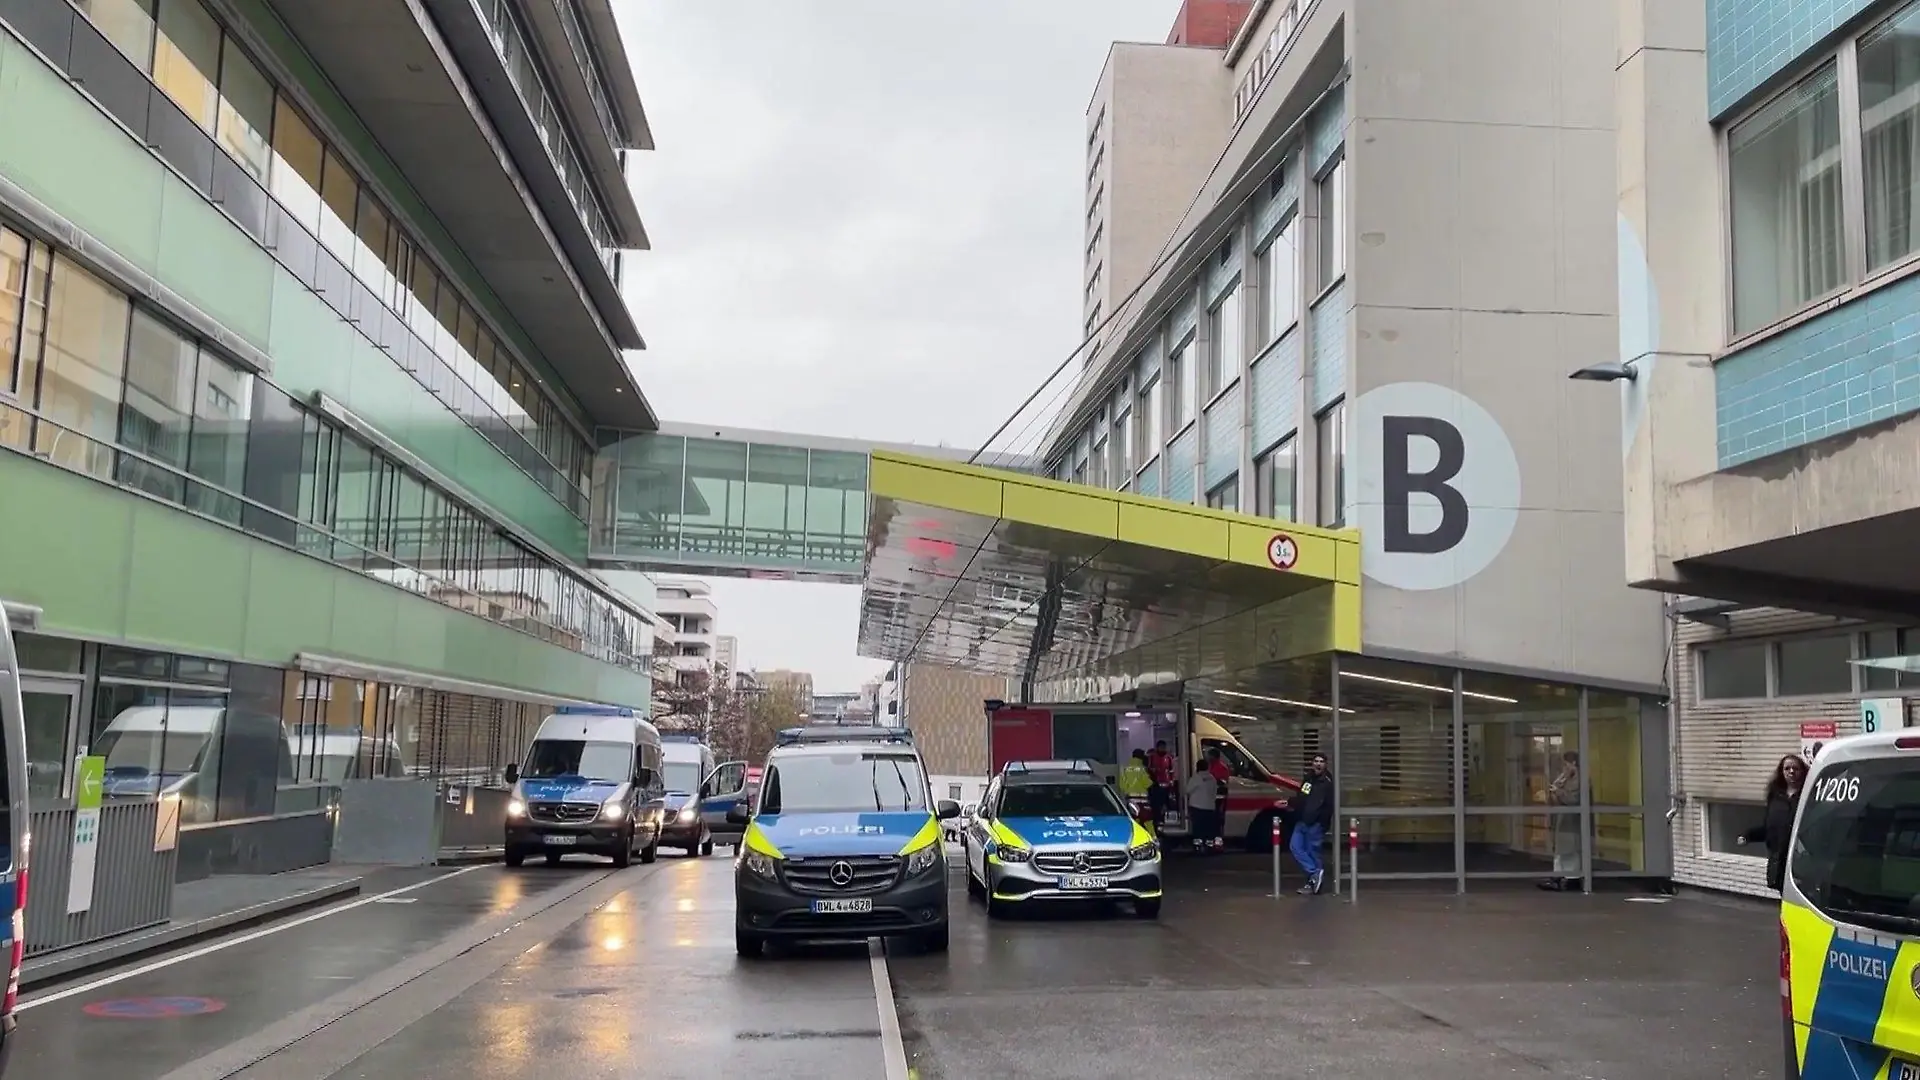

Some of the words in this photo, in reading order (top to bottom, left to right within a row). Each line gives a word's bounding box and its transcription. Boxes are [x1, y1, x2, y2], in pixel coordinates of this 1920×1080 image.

[1383, 415, 1470, 554] B
[1865, 710, 1875, 733] B
[1815, 777, 1860, 802] 1/206
[799, 825, 885, 836] POLIZEI
[1042, 830, 1109, 838] POLIZEI
[1829, 950, 1888, 980] POLIZEI
